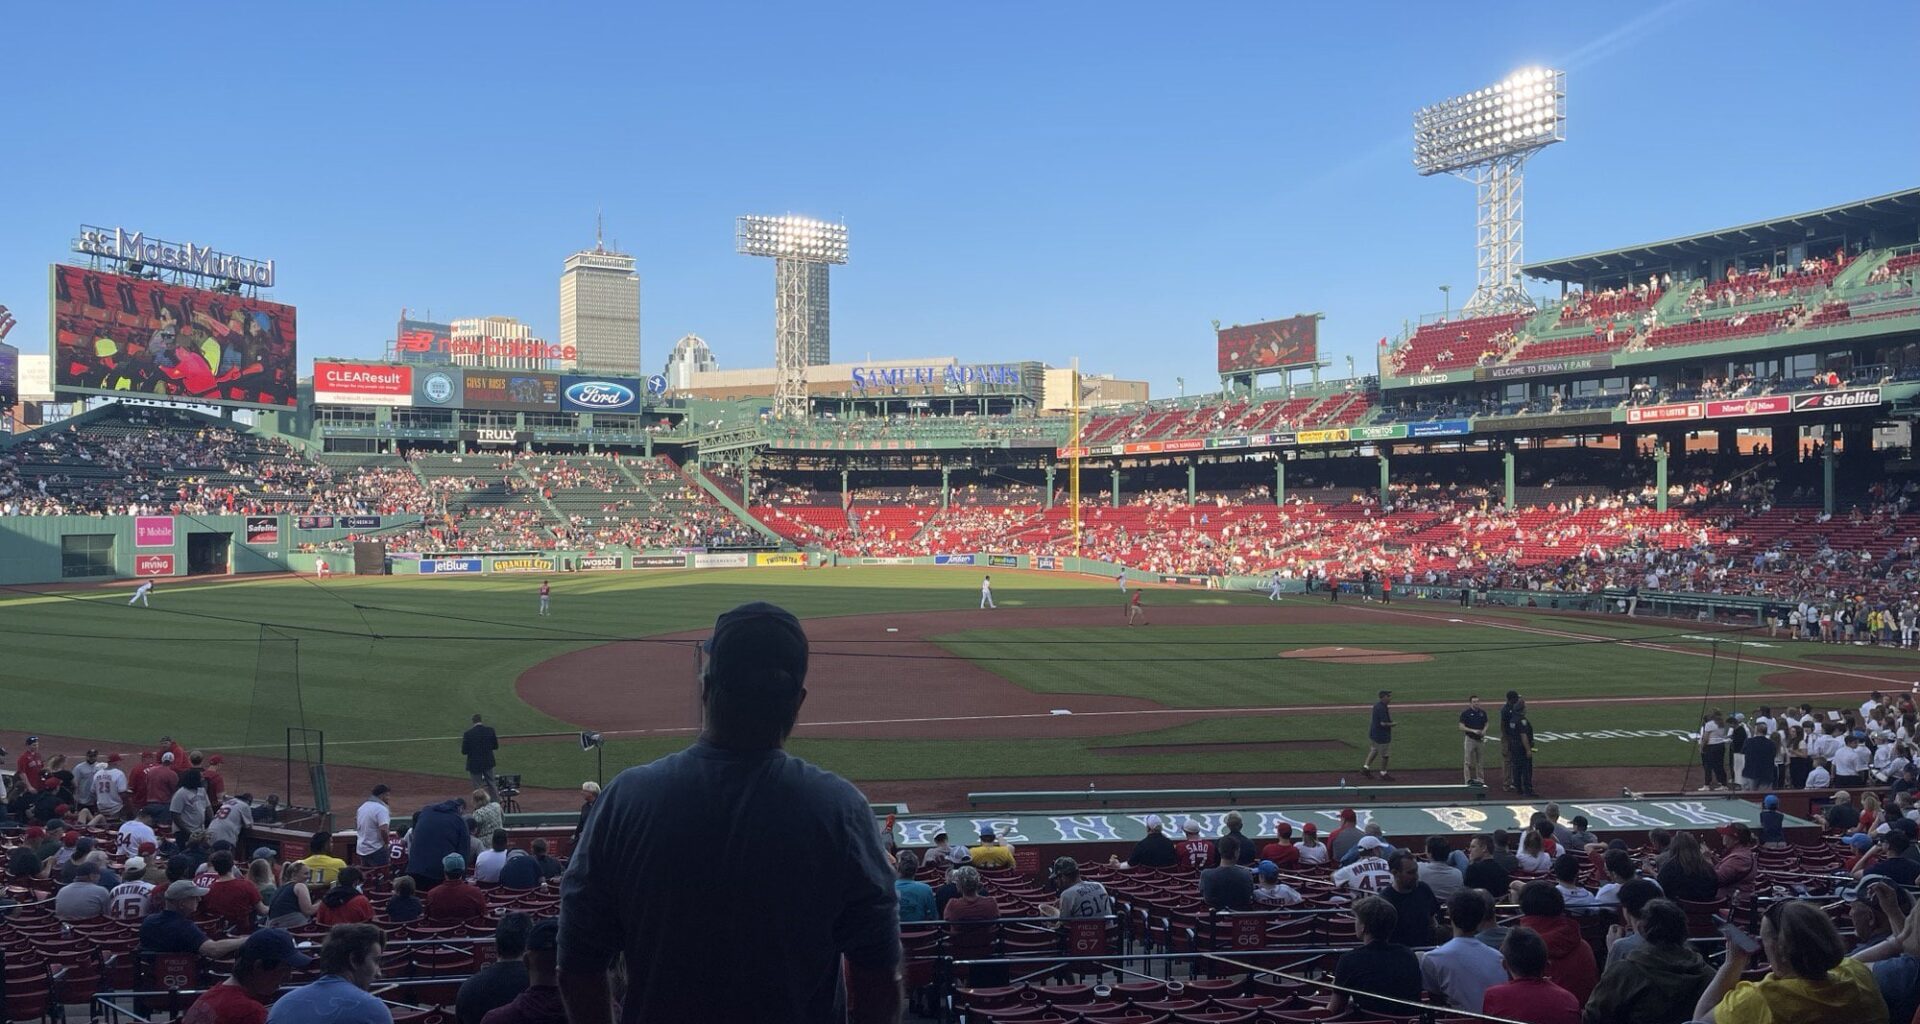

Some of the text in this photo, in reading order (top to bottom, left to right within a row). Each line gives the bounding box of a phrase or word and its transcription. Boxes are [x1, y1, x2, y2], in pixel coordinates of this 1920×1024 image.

[116, 227, 275, 287] MassMutual
[485, 335, 577, 360] balance
[1493, 359, 1592, 377] WELCOME TO FENWAY PARK
[326, 370, 401, 385] CLEAResult
[1418, 374, 1448, 385] UNITED
[579, 385, 620, 405] Ford
[1823, 390, 1880, 407] Safelite
[1721, 402, 1776, 414] Ninety Nine
[477, 429, 517, 440] TRULY
[147, 527, 172, 537] Mobile
[141, 561, 168, 570] IRVING
[434, 560, 469, 573] jetBlue
[494, 559, 554, 570] GRANITE CITY
[583, 557, 616, 567] wasabi
[1484, 729, 1691, 743] piration
[1186, 840, 1209, 852] SABO
[1352, 862, 1390, 876] MARTINE
[111, 897, 141, 919] 45
[1080, 894, 1109, 918] 617
[1077, 939, 1099, 950] 67
[1238, 934, 1260, 946] 66
[164, 975, 189, 986] 69
